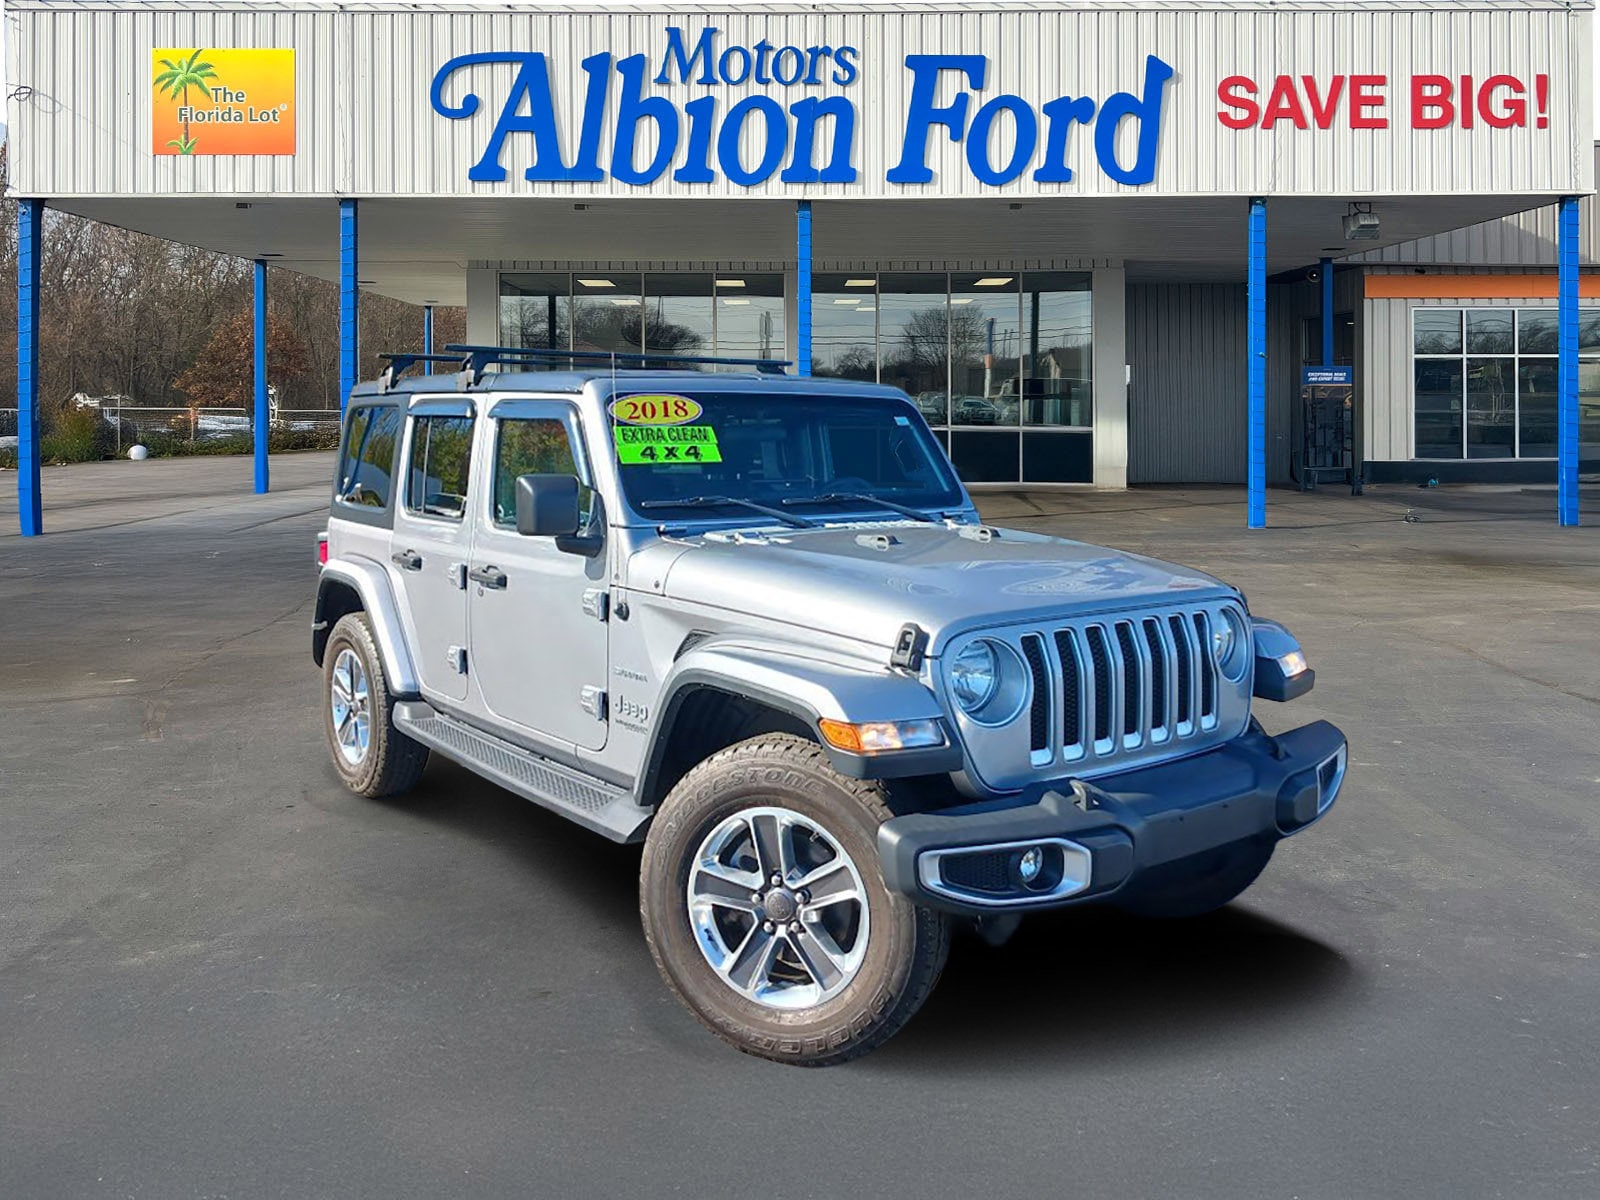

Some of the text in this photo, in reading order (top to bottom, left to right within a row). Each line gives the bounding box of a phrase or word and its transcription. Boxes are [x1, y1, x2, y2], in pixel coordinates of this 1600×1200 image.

[654, 26, 857, 85] Motors
[210, 86, 246, 104] The
[1217, 74, 1549, 129] SAVE BIG!
[177, 106, 280, 123] Florida Lot
[430, 52, 1174, 186] Albion Ford
[624, 400, 689, 420] 2018
[620, 426, 709, 442] EXTRA CLEAN
